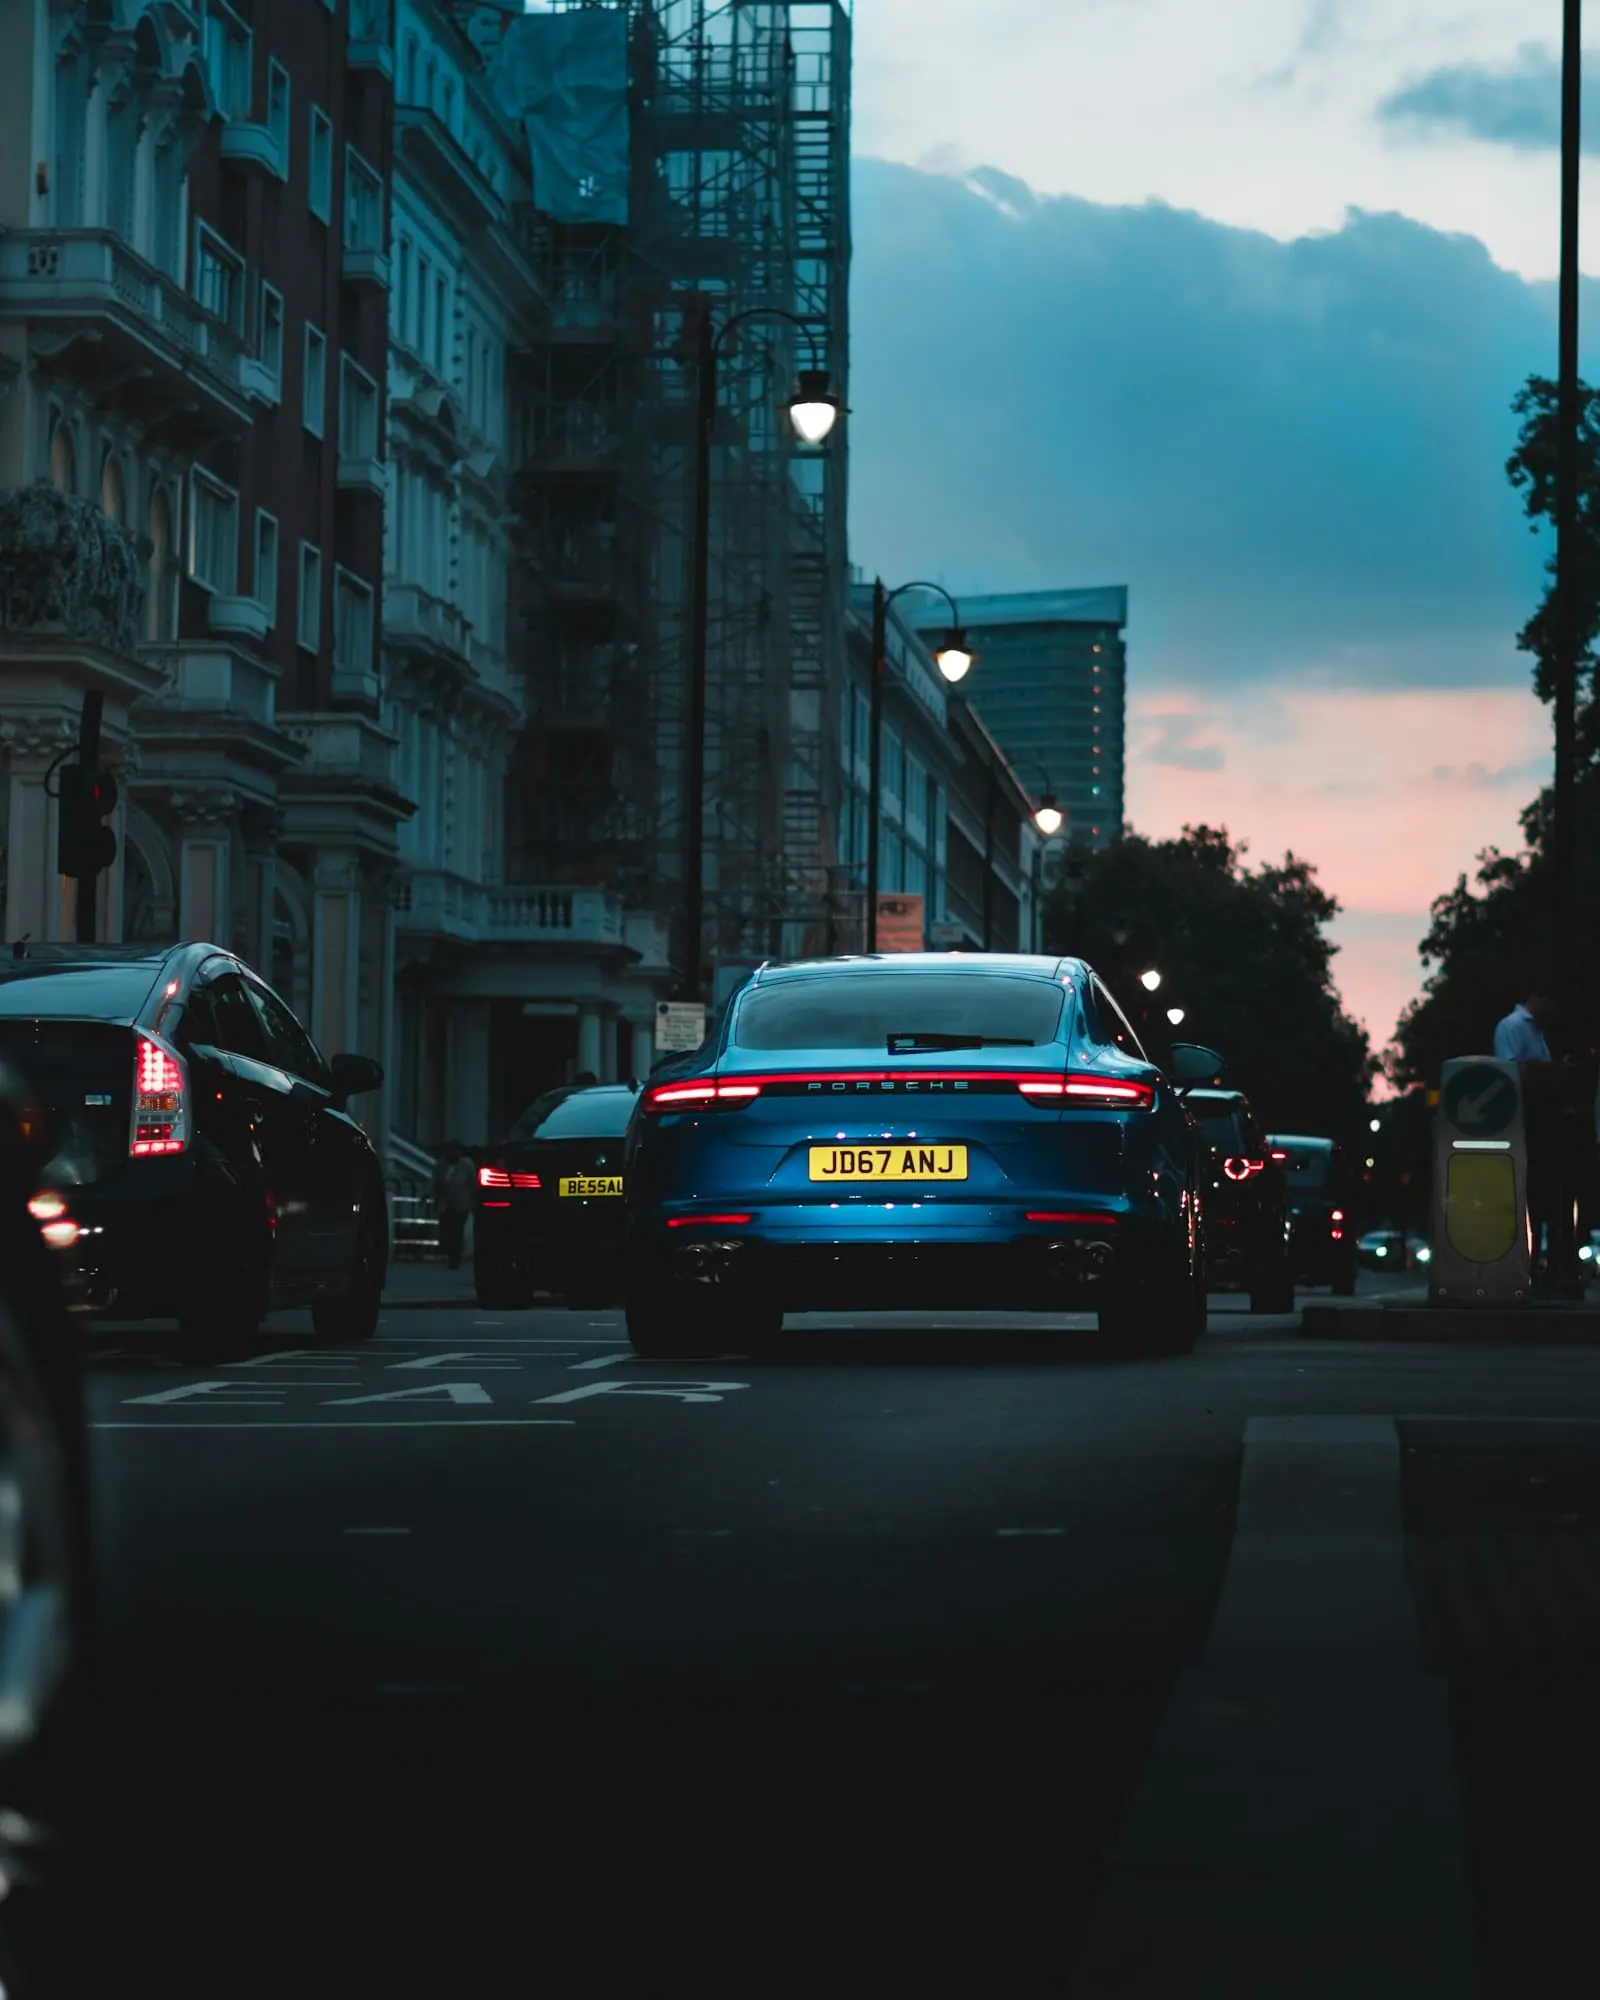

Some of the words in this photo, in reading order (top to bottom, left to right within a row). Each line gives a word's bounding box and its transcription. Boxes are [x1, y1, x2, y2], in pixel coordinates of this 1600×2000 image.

[807, 1081, 969, 1090] PORSCHE
[822, 1150, 892, 1174] JD67
[901, 1149, 953, 1174] ANJ
[120, 1380, 751, 1405] EAR
